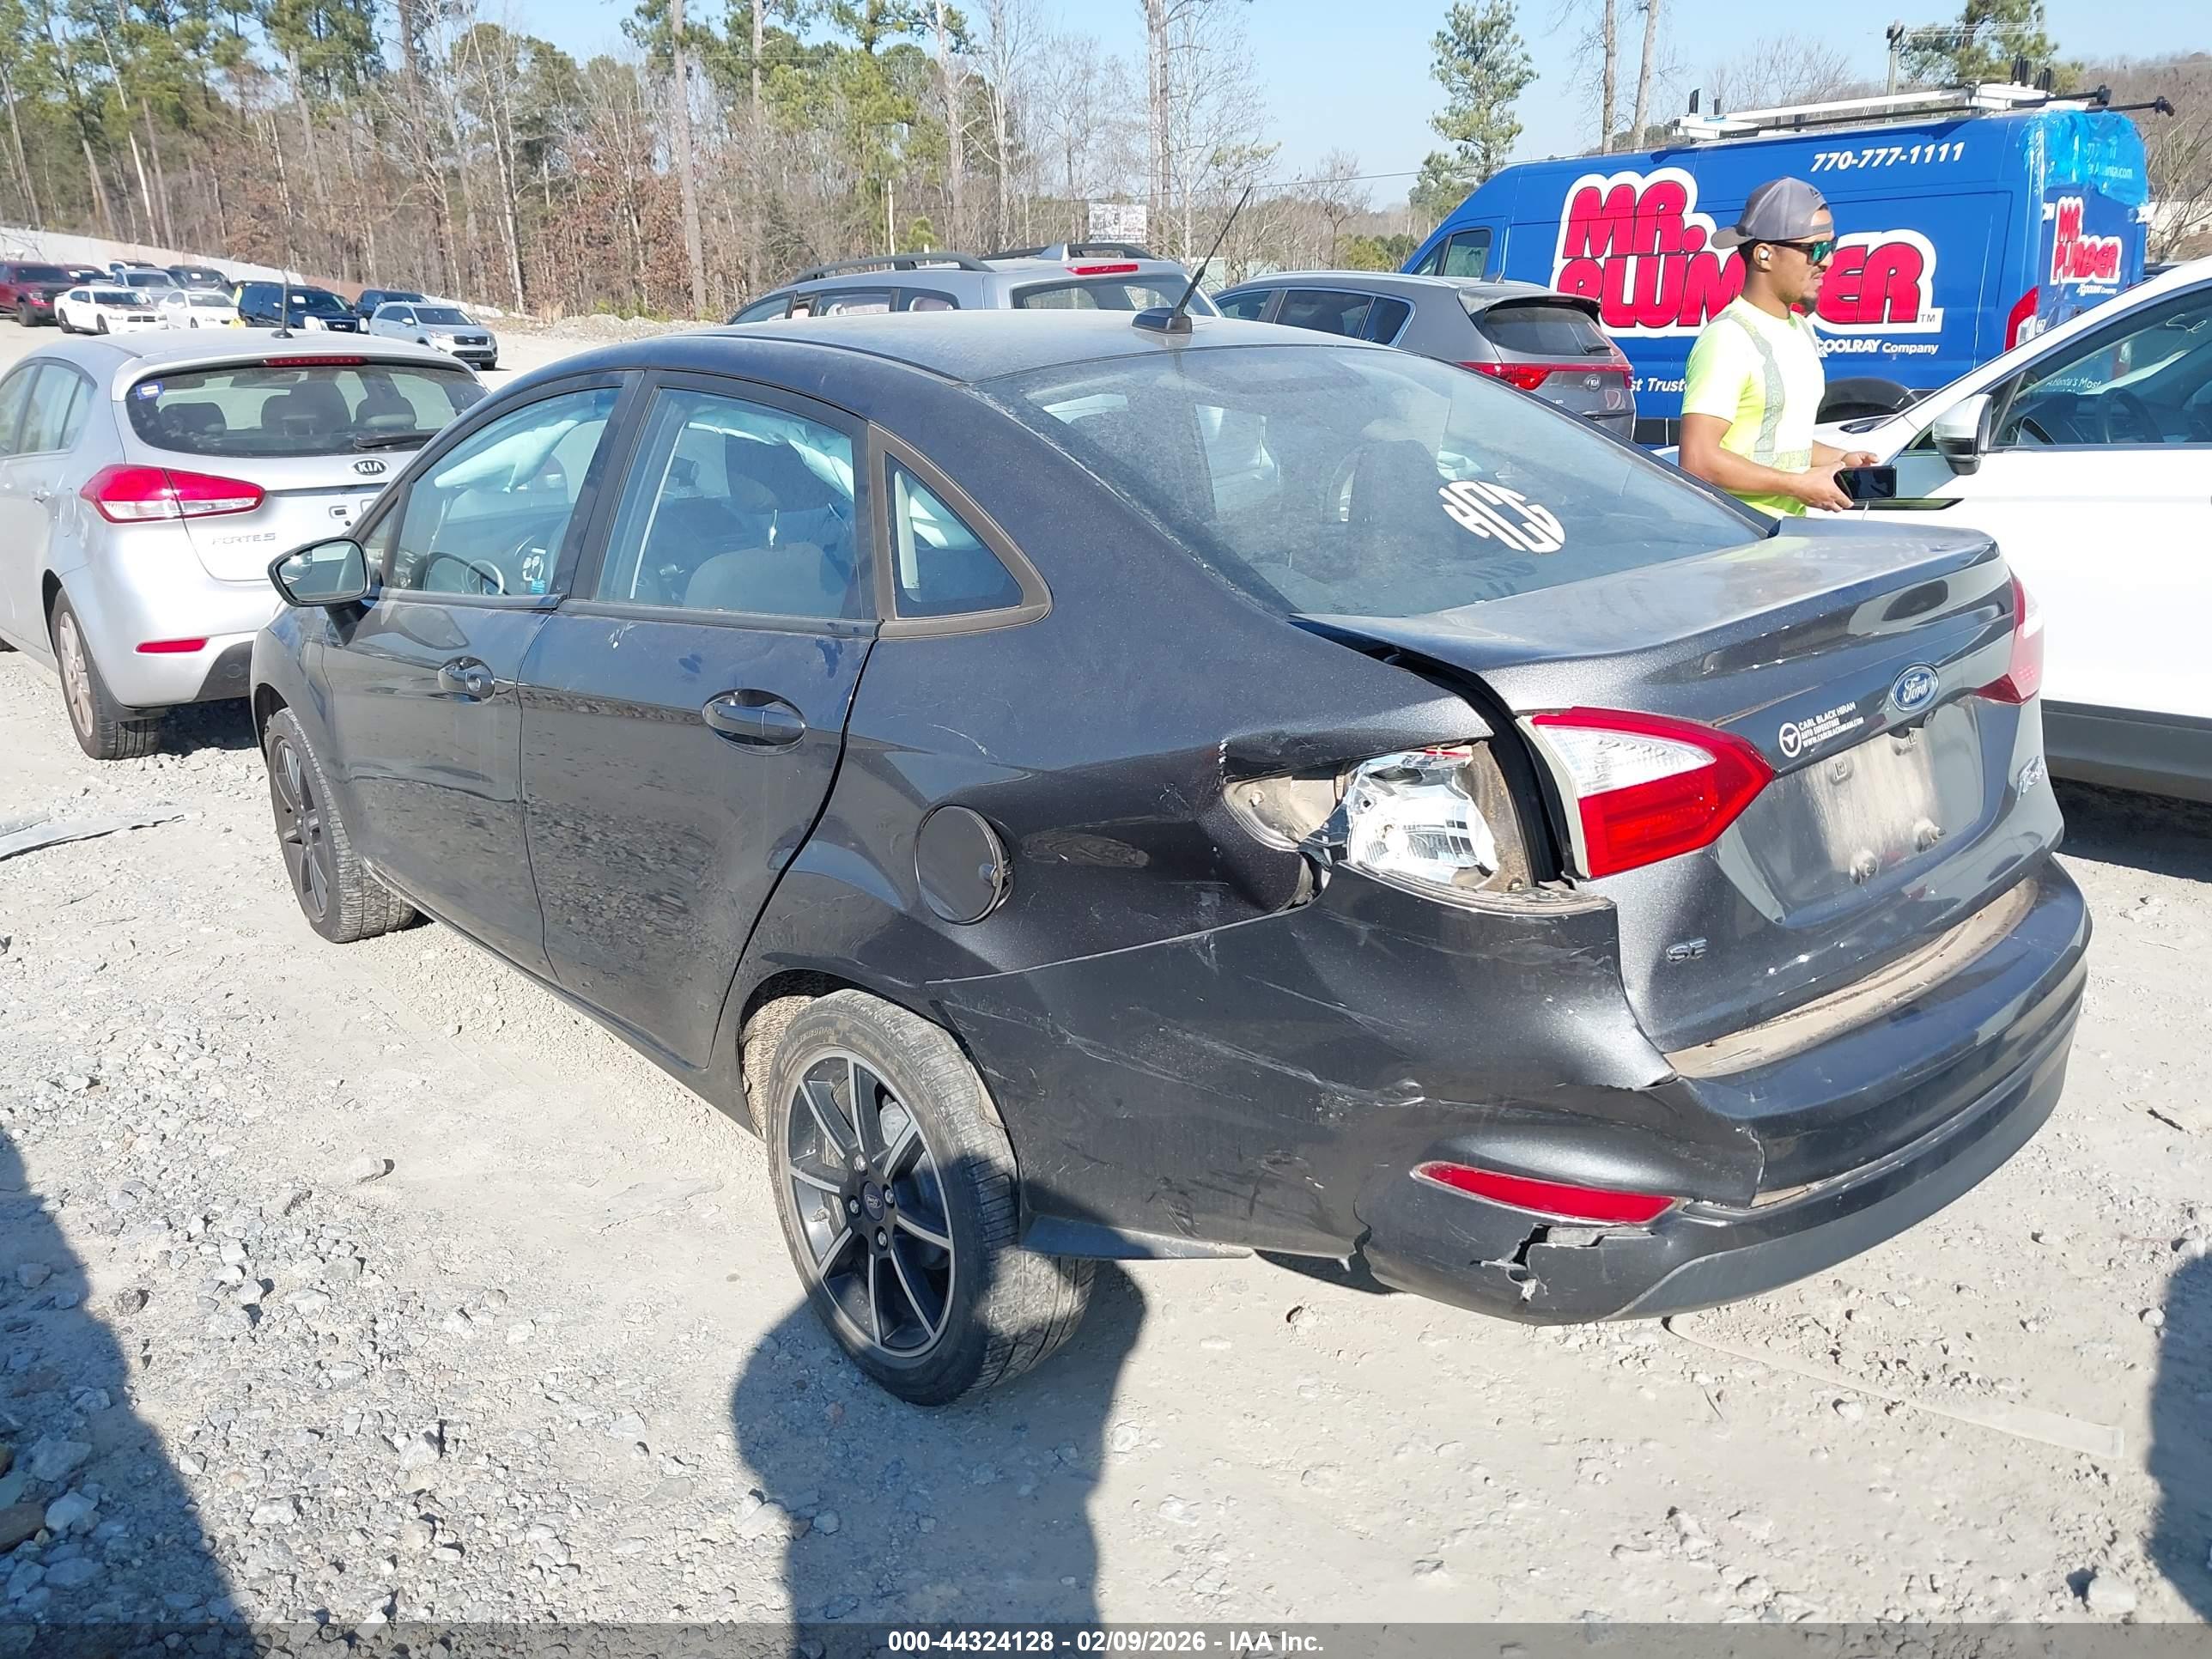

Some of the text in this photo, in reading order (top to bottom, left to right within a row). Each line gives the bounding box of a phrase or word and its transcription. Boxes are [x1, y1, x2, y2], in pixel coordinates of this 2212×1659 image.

[1810, 142, 1965, 172] 770-777-1111
[1563, 179, 1707, 258] MR.
[1557, 241, 1925, 328] PLUMER
[1882, 342, 1939, 356] Company
[1648, 378, 1687, 392] Trust
[357, 462, 383, 472] KIA
[1798, 701, 1856, 731] CARL BLACK HIRAM
[1801, 728, 1814, 739] AUTO
[1667, 939, 1707, 962] SE
